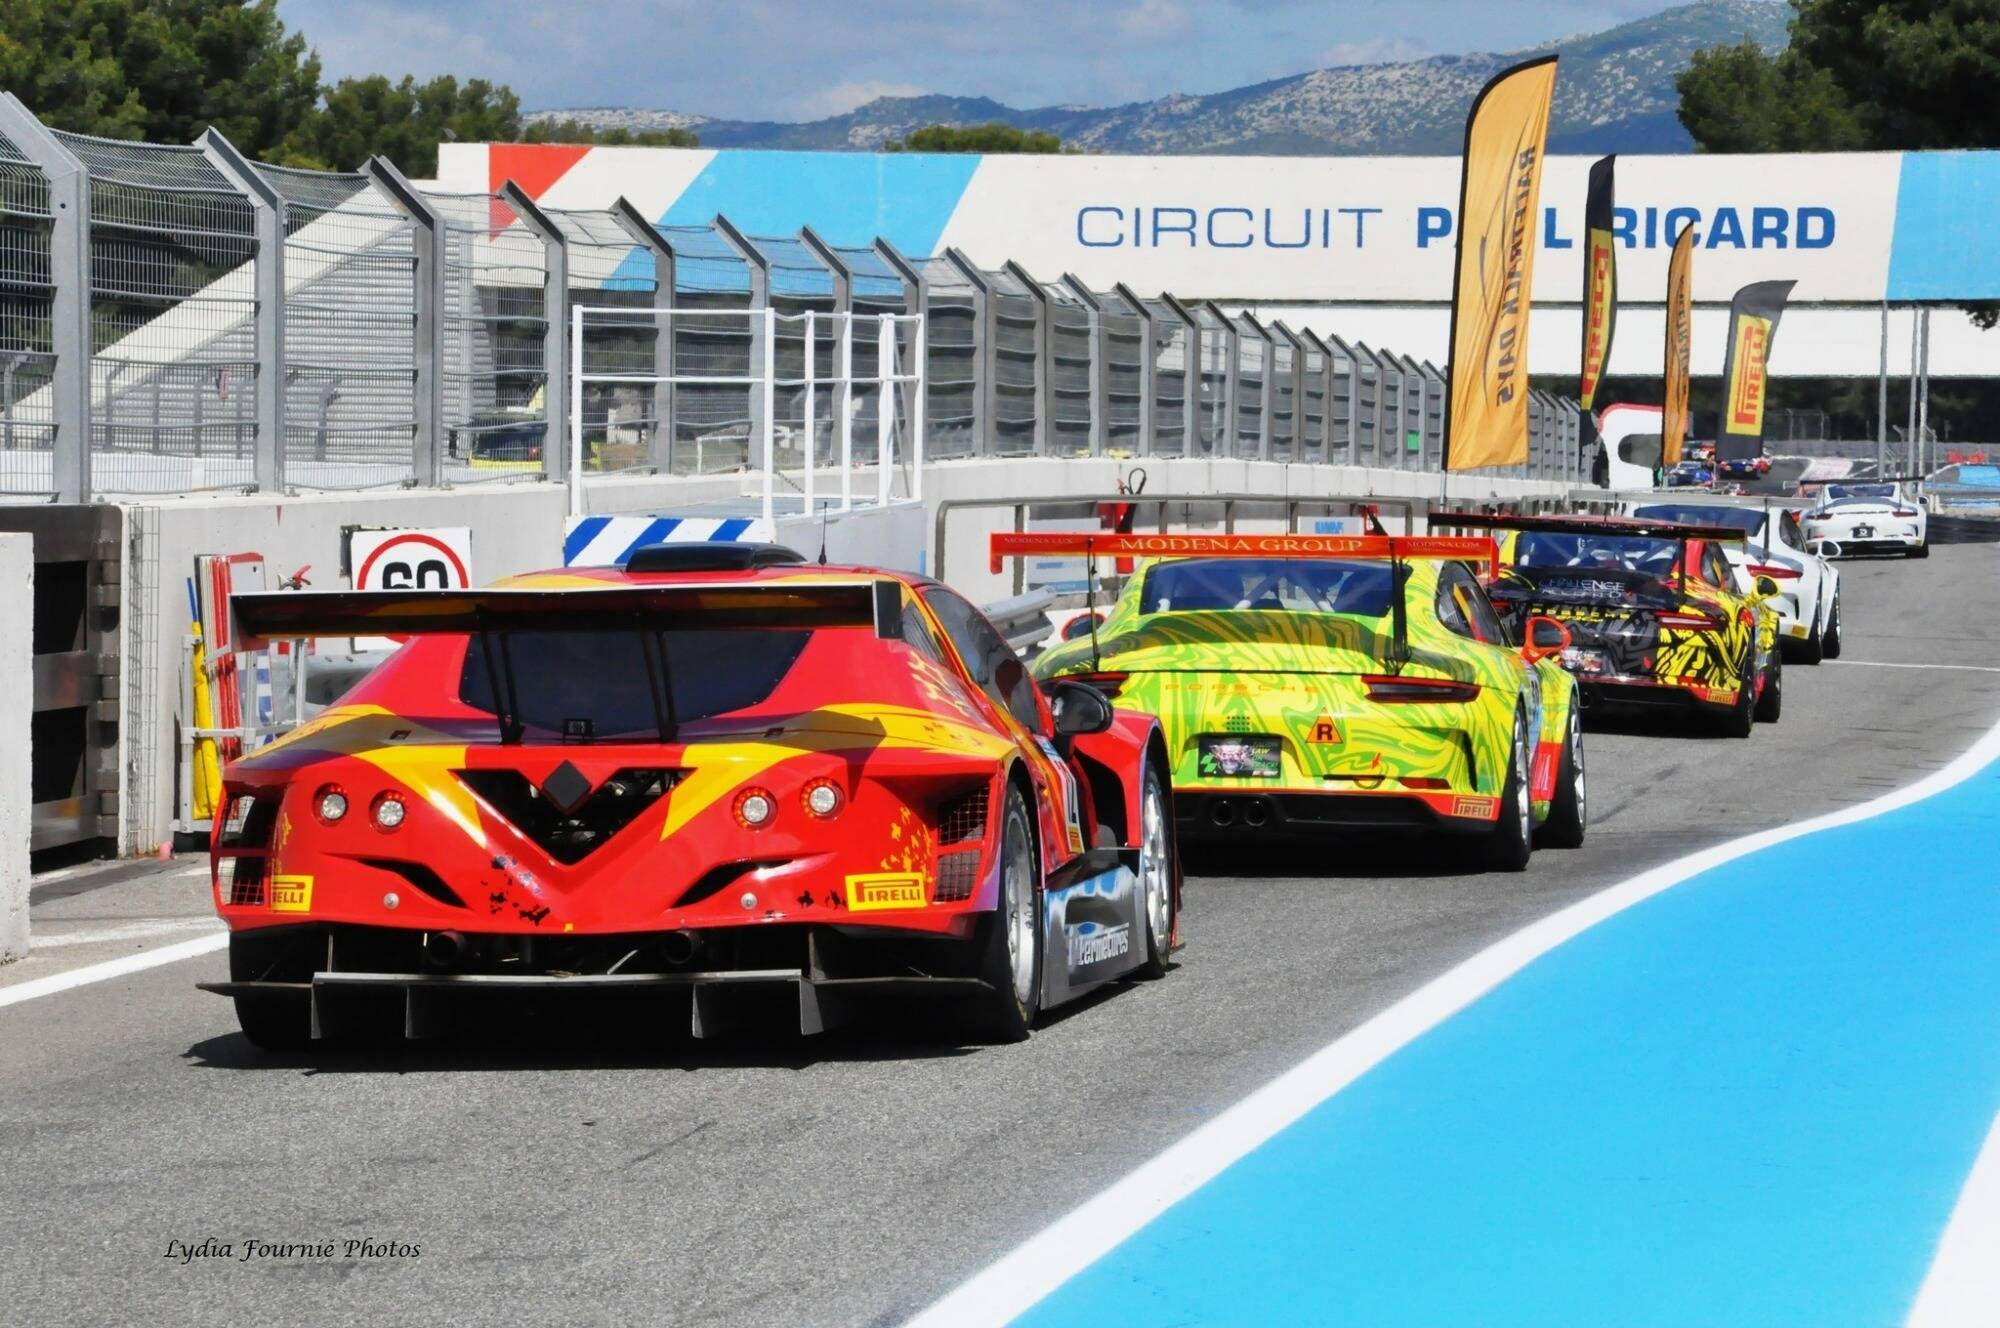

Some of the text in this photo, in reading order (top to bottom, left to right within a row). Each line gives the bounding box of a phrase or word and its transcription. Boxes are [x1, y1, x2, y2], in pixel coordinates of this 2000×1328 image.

[1077, 206, 1836, 248] CIRCUIT PL RICARD
[1734, 325, 1765, 425] PIRELLI
[1120, 537, 1363, 552] MODENA GROUP
[1316, 723, 1333, 741] R
[854, 878, 921, 904] PIRELLI
